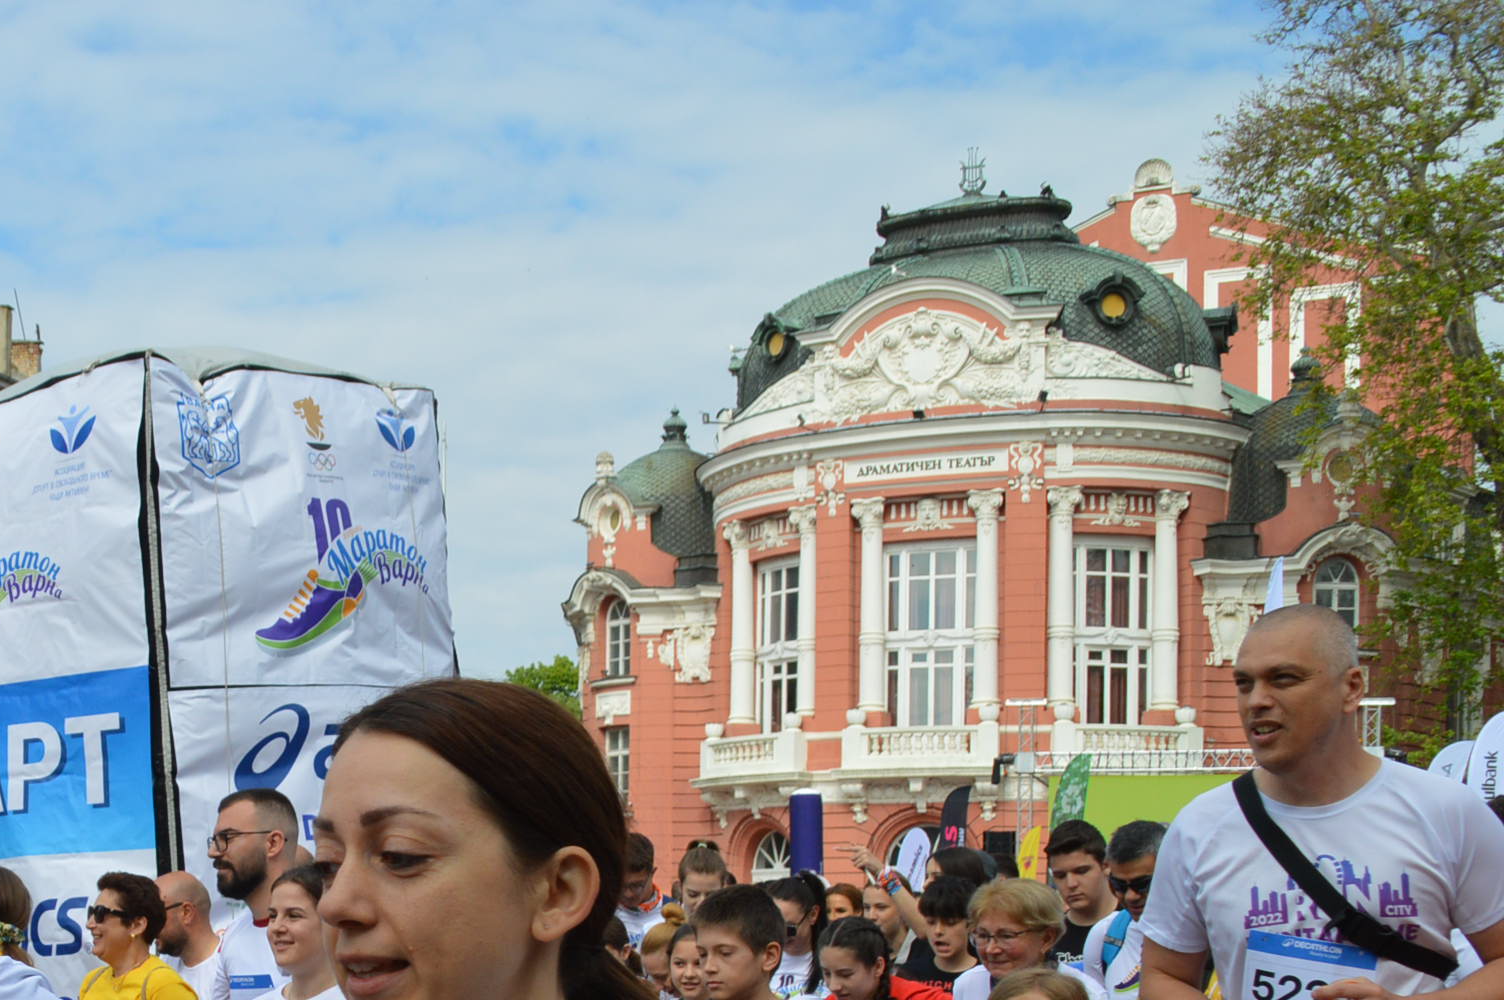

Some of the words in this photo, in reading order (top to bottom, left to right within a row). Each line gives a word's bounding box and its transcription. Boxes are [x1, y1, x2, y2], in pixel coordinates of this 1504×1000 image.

[857, 459, 942, 478] ДРАМАТИЧЕН
[947, 456, 996, 470] ТЕАТЪР
[307, 497, 353, 566] 10
[327, 528, 428, 587] Маратон
[372, 552, 430, 594] Варна
[4, 573, 63, 603] Варна
[1481, 751, 1499, 800] ulbank
[1249, 913, 1284, 927] 2022
[1385, 904, 1413, 916] CITY
